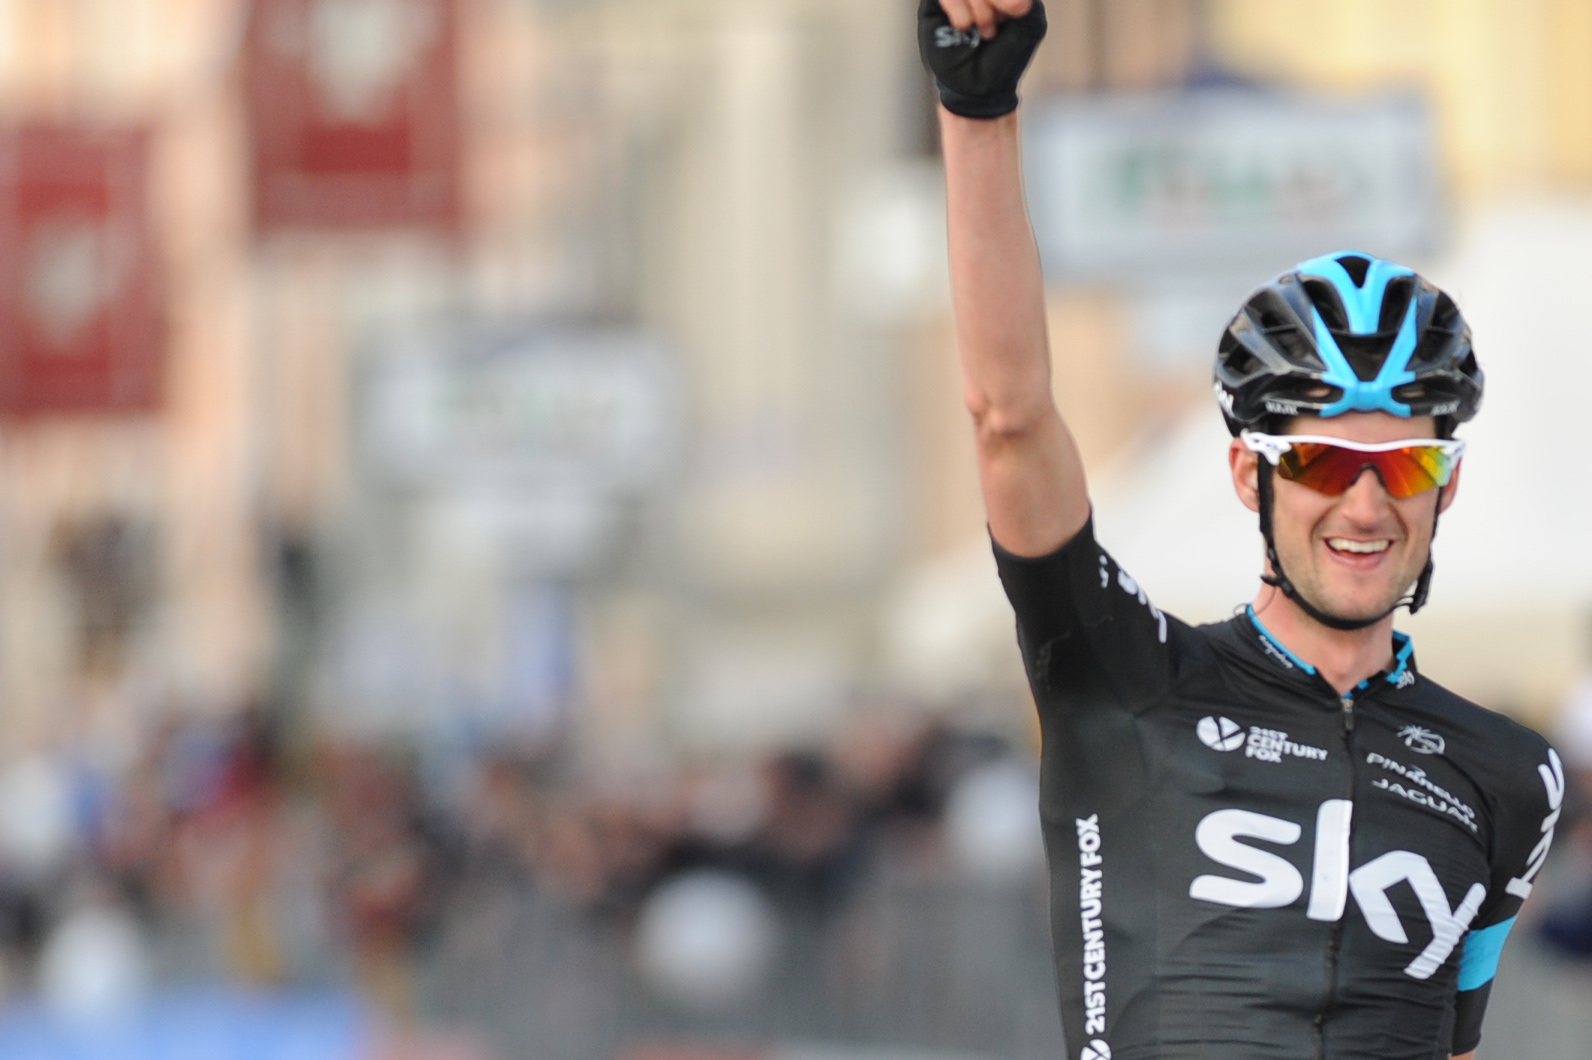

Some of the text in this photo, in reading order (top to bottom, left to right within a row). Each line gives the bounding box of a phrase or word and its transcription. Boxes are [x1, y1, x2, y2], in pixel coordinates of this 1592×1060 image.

[1245, 744, 1282, 763] FOX
[1247, 733, 1328, 761] CENTURY
[1371, 778, 1478, 833] JAGUAR
[1189, 799, 1487, 980] sky
[1075, 812, 1106, 1035] 21ST CENTURY FOX
